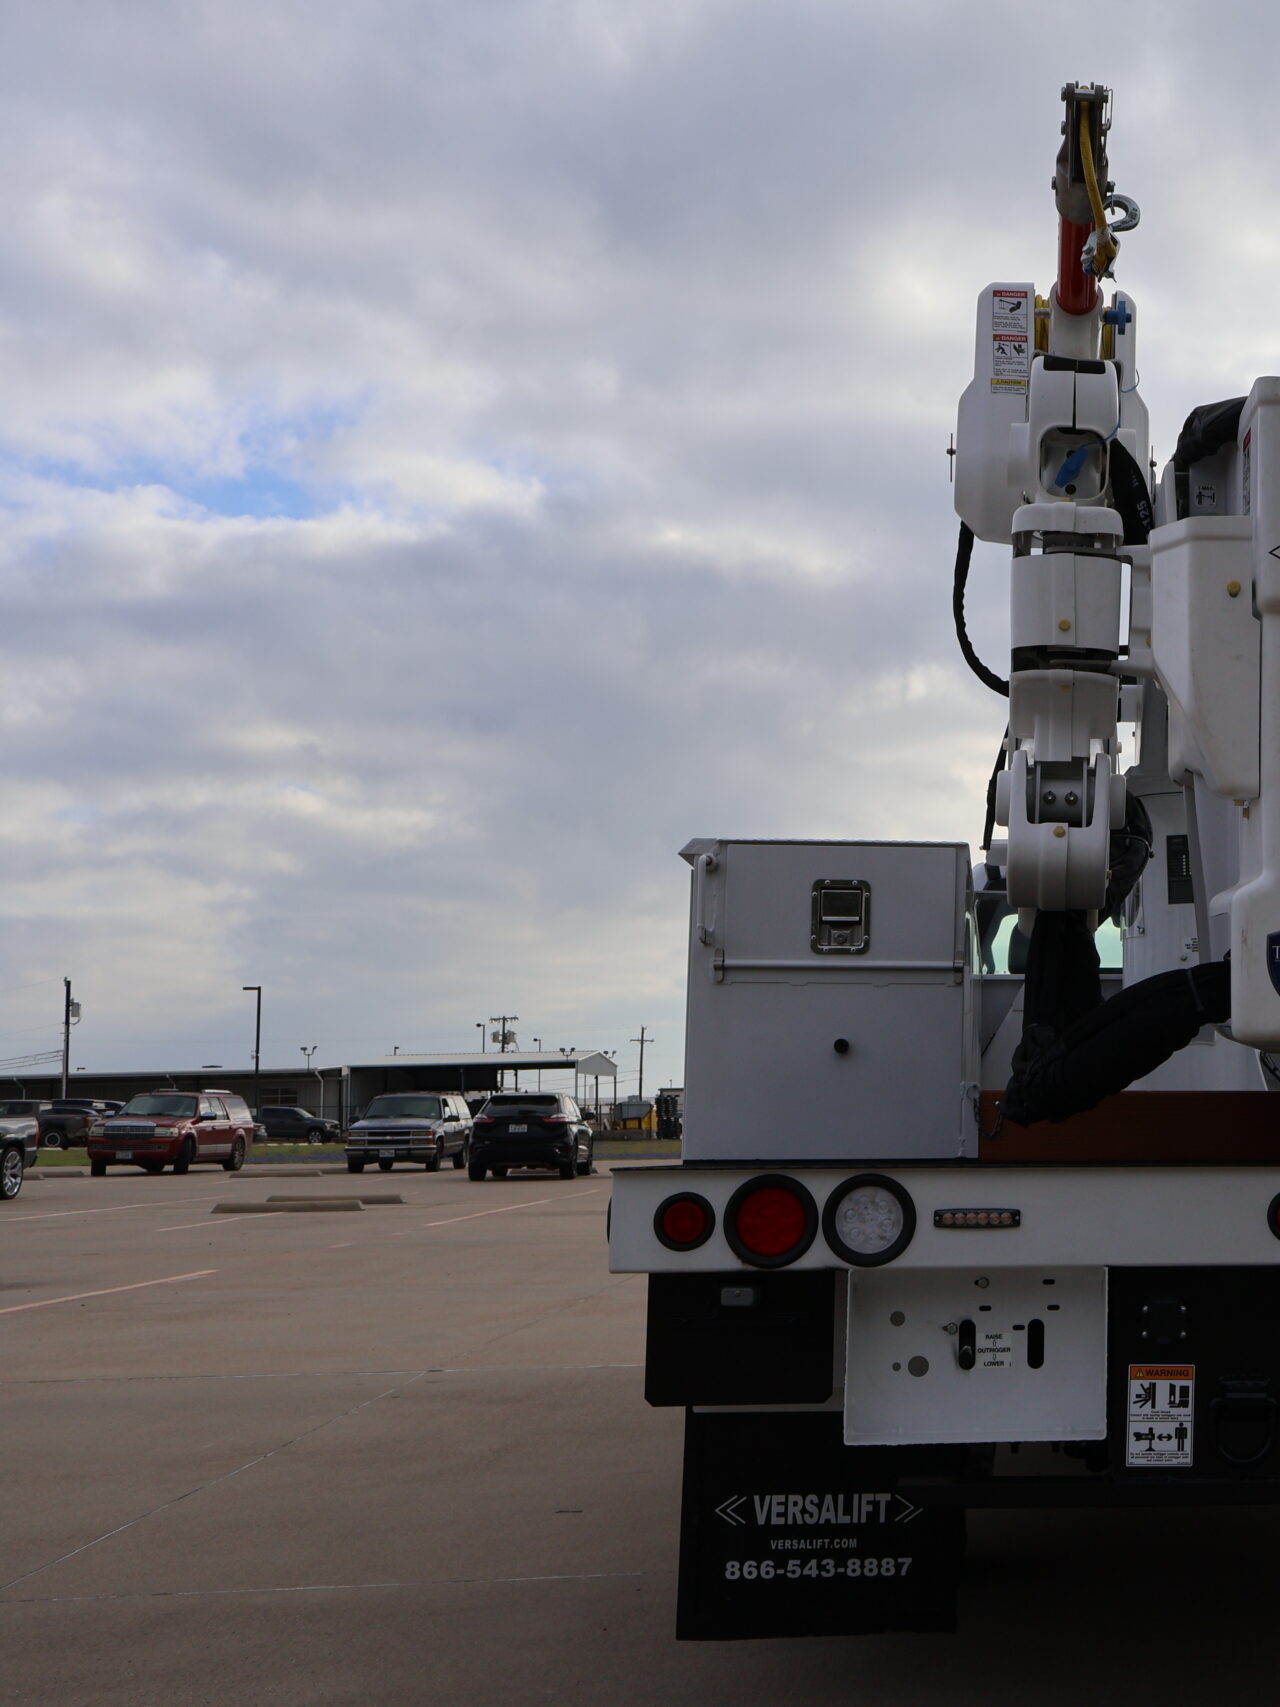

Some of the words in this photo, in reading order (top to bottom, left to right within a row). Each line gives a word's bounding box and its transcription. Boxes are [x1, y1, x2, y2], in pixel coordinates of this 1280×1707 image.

[1146, 1368, 1190, 1377] WARNING
[753, 1493, 891, 1525] VERSALIFT
[770, 1538, 857, 1550] VERSALIFT.COM
[724, 1557, 912, 1580] 866-543-8887
